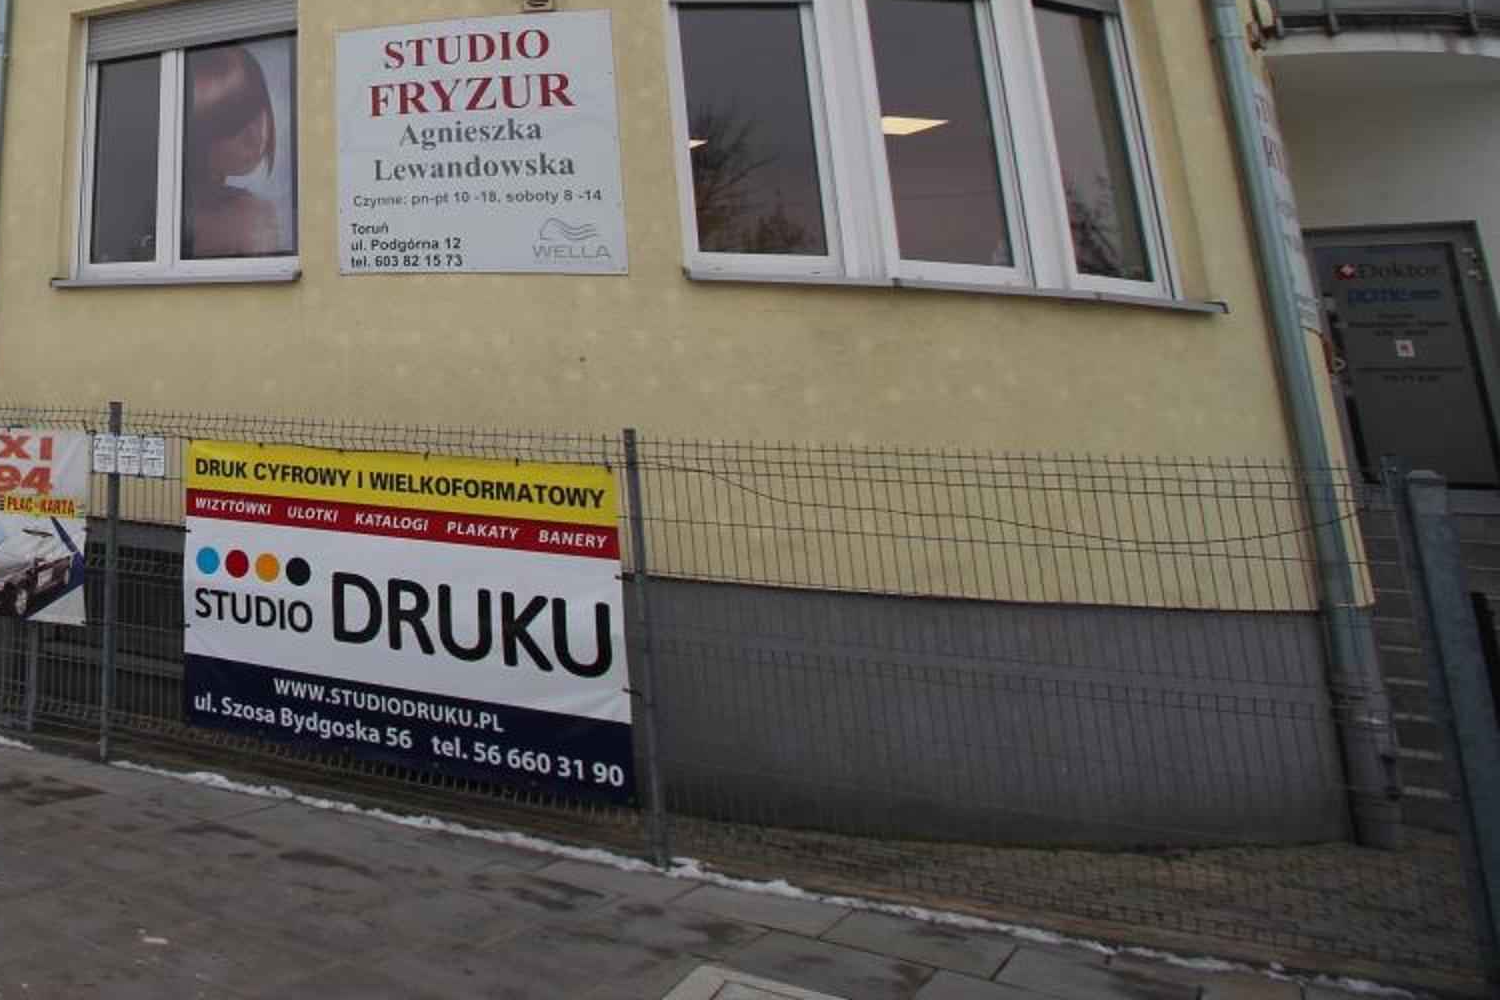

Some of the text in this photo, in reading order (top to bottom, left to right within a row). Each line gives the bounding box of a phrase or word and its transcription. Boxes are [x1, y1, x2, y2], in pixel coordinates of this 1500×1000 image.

[384, 29, 550, 70] STUDIO
[368, 72, 577, 118] FRYZUR
[399, 118, 543, 150] Agnieszka
[374, 152, 576, 182] Lewandowska
[353, 194, 407, 208] Czynne:
[411, 192, 449, 206] pn-pt
[454, 191, 470, 203] 10
[506, 189, 559, 205] soboty
[563, 189, 574, 201] 8
[351, 221, 389, 235] Toruń
[351, 237, 462, 253] ul. Podgórna 12
[351, 254, 463, 268] tel. 603 82 15 73
[531, 244, 612, 259] WELLA
[195, 457, 606, 508] DRUK CYFROWY I WIELKOFORMATOWY
[195, 496, 607, 549] WIZYTÓWKI ULOTKI KATALOGI PLAKATY BANERY
[195, 571, 613, 679] STUDIO DRUKU
[273, 677, 505, 733] WWW.STUDIODRUKU.PL
[194, 694, 625, 787] ul. Szosa Bydgoska 56 tel. 56 660 31 90
